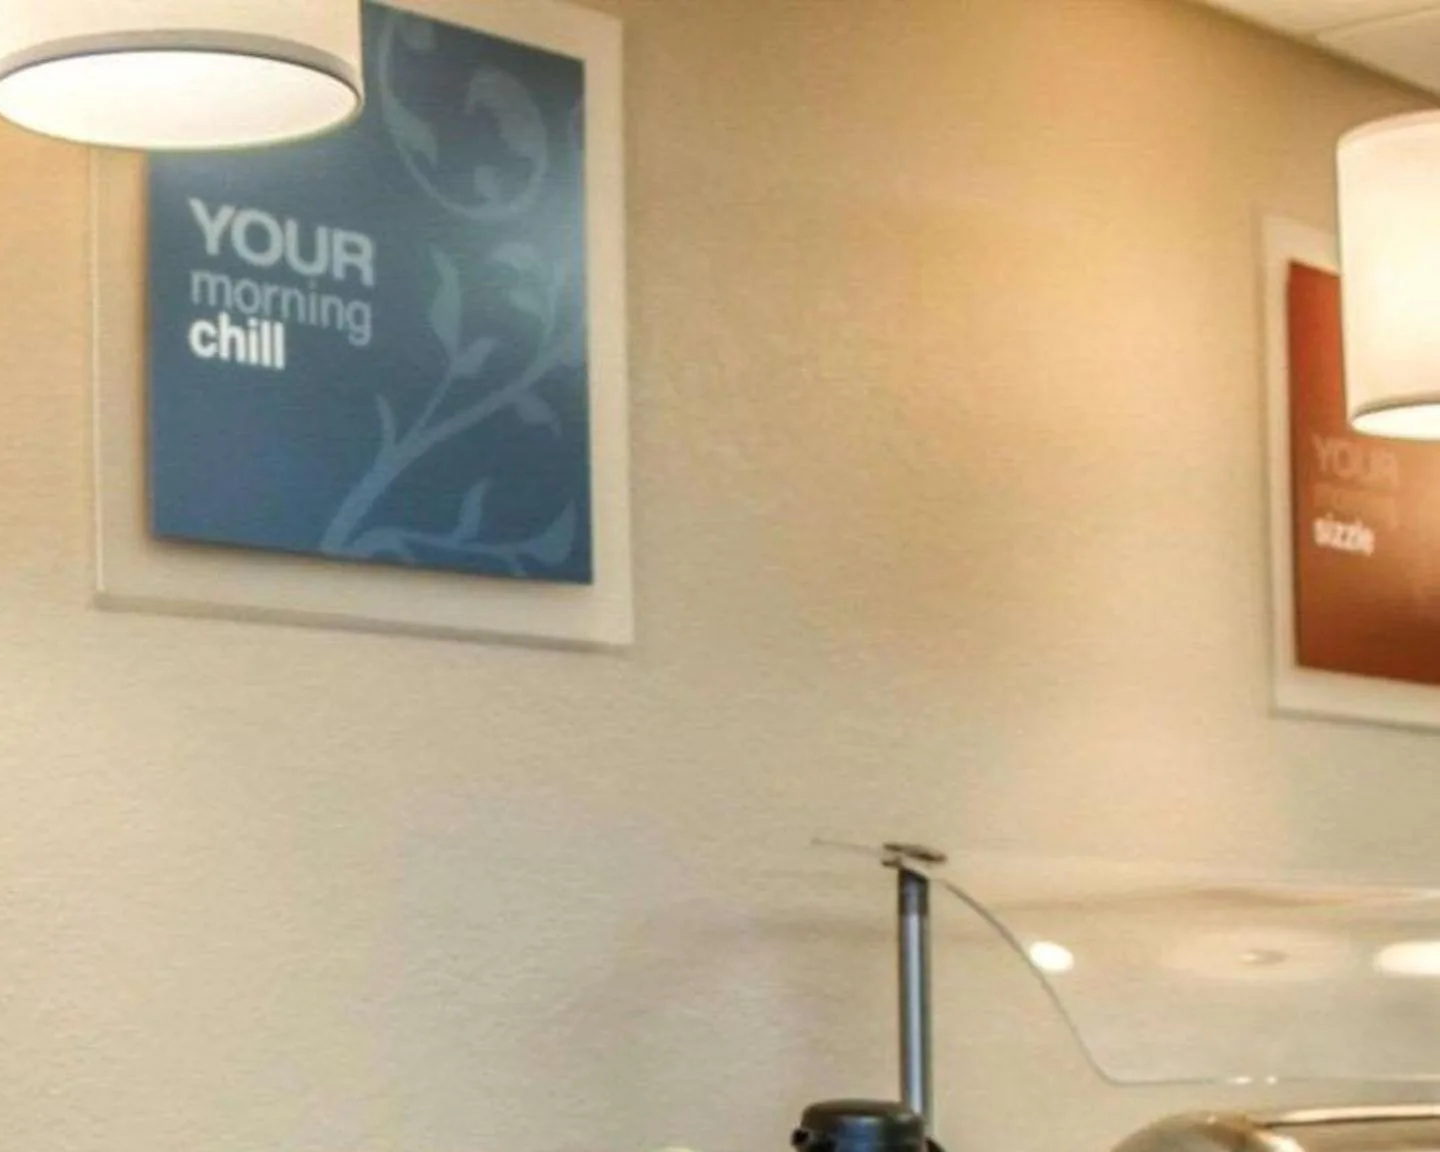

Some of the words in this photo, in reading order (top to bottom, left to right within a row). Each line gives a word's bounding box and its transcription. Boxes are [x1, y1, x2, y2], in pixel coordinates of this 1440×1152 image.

[188, 197, 375, 287] YOUR
[188, 310, 285, 370] chill
[190, 269, 372, 346] morning
